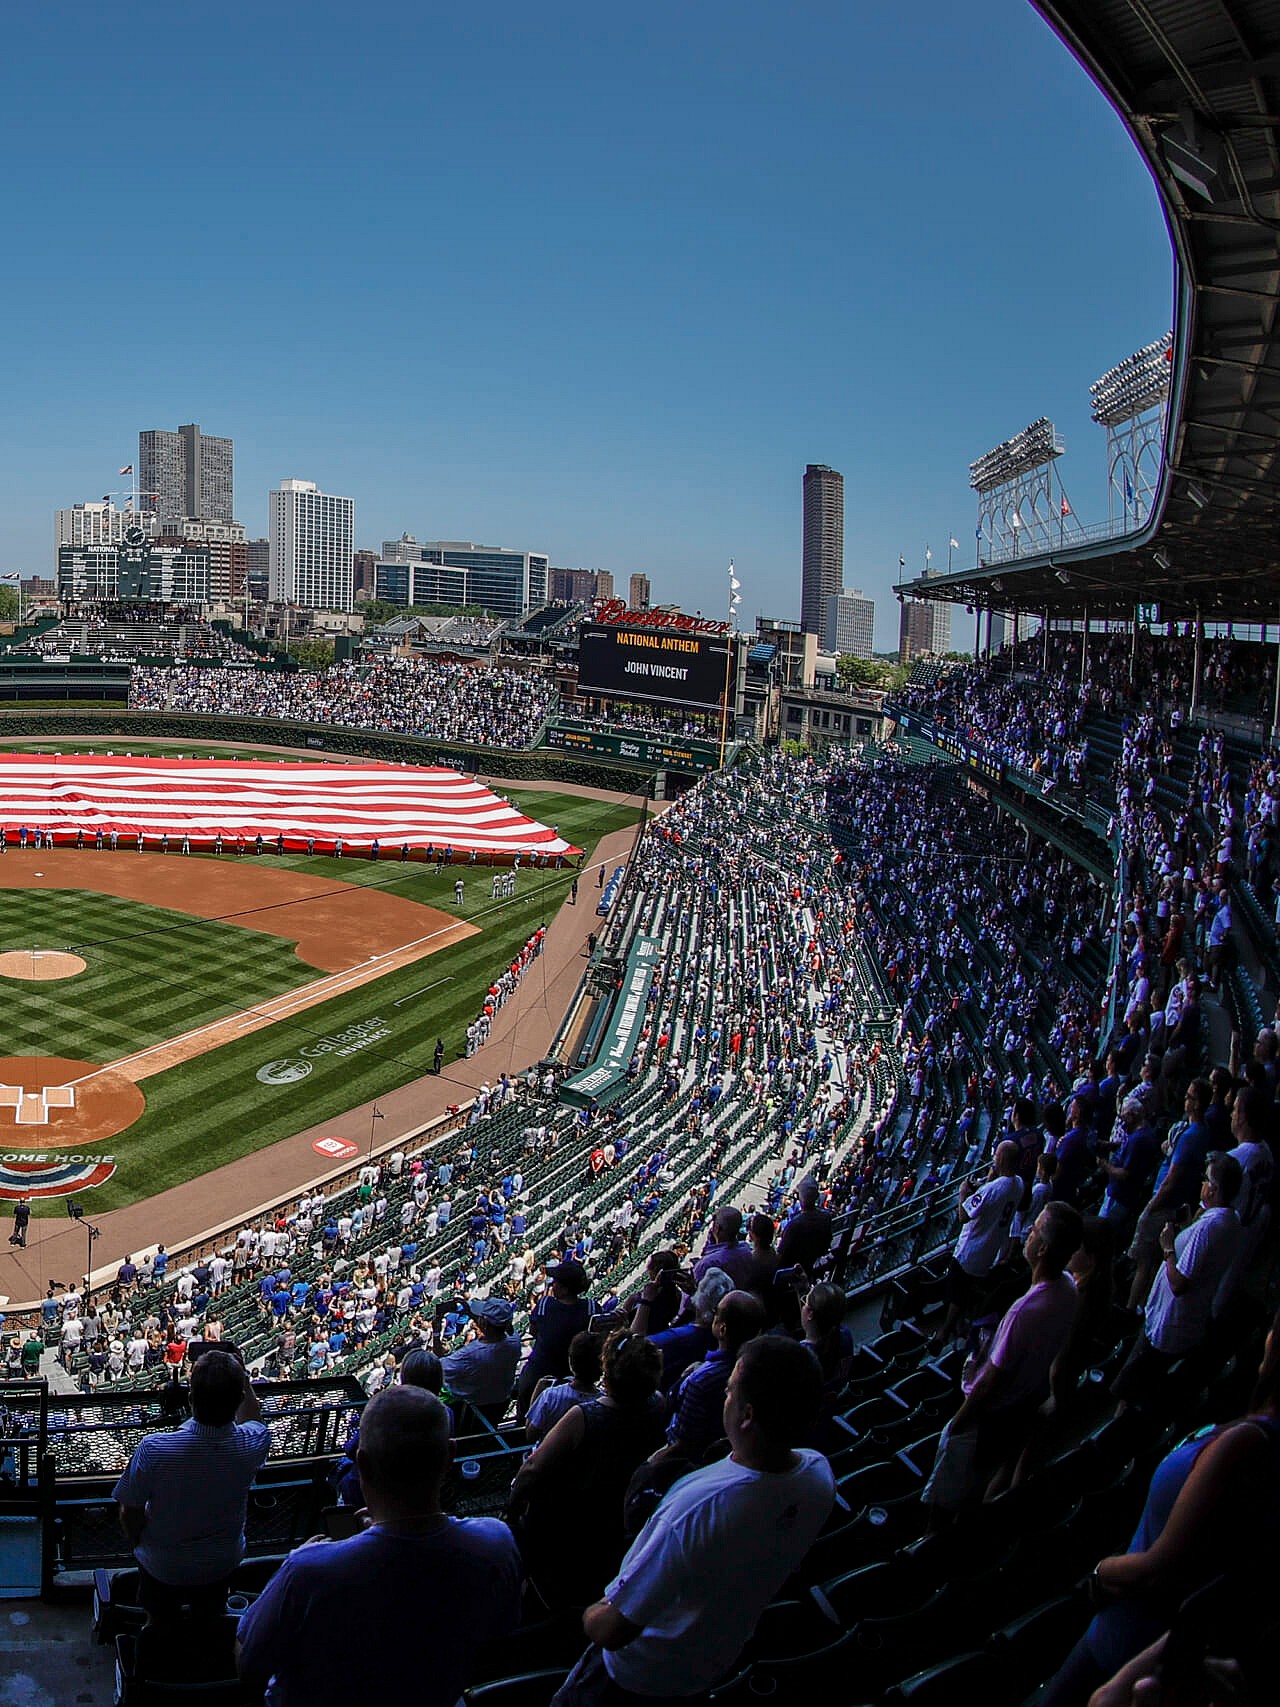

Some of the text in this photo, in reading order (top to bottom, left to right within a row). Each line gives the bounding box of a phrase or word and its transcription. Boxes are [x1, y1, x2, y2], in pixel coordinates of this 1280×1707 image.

[593, 598, 731, 633] Budweiser
[616, 632, 699, 653] NATIONAL ANTHEM
[624, 660, 689, 681] JOHN VINCENT
[438, 757, 465, 766] SLOAN
[299, 1016, 388, 1057] Gallagher
[334, 1028, 393, 1057] INSURANCE
[53, 1154, 115, 1163] HOME
